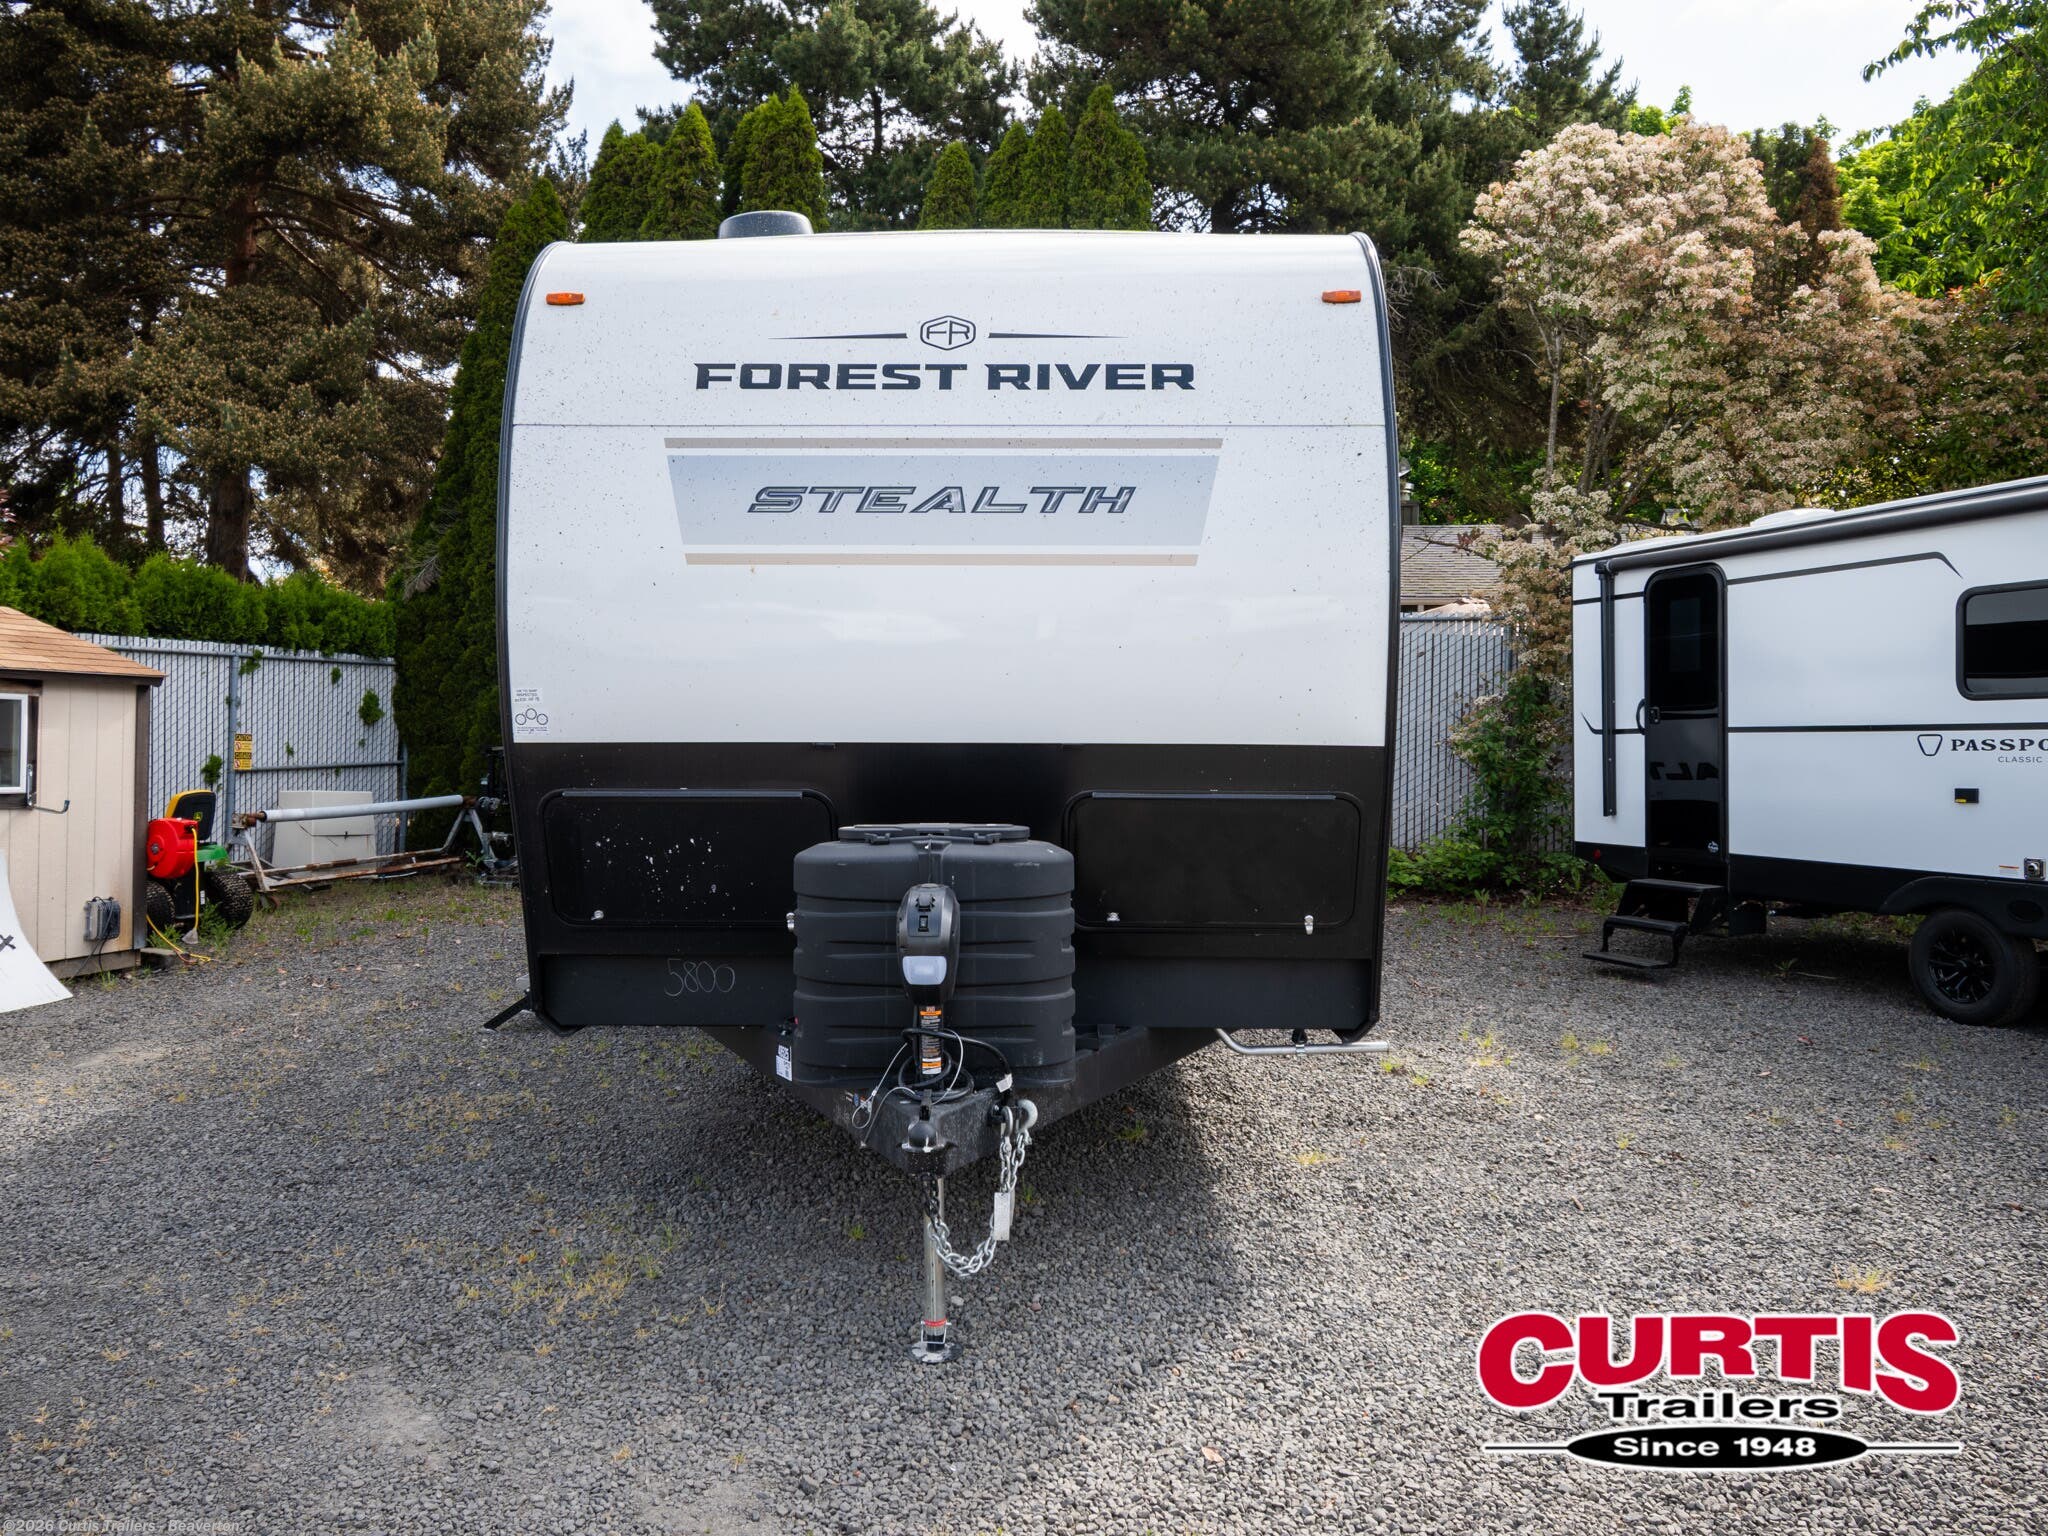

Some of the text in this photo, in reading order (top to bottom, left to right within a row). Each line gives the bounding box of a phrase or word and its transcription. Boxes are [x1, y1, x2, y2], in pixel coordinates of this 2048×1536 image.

[926, 320, 970, 345] FR
[694, 362, 1197, 391] FOREST RIVER
[747, 485, 1137, 514] STEALTH
[664, 958, 736, 997] 5800
